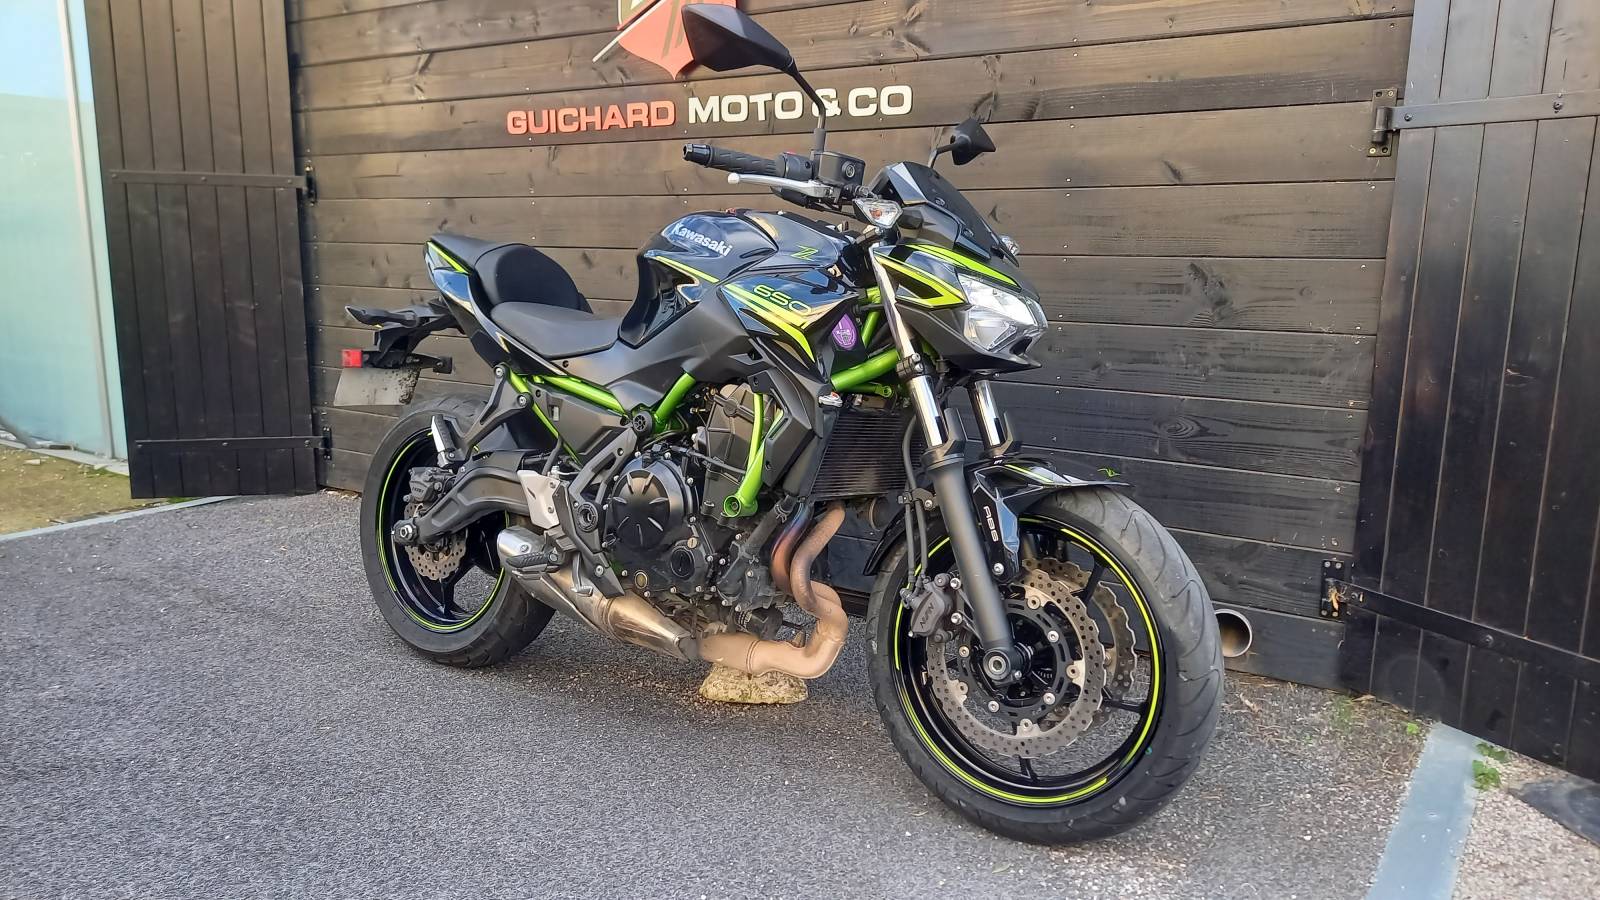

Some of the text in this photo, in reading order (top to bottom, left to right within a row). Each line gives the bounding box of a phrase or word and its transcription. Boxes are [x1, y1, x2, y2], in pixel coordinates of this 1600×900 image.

[507, 85, 912, 134] GUICHARD MOTO & CO
[671, 222, 732, 256] Kawasaki
[753, 284, 812, 316] 650
[983, 505, 998, 542] ABS
